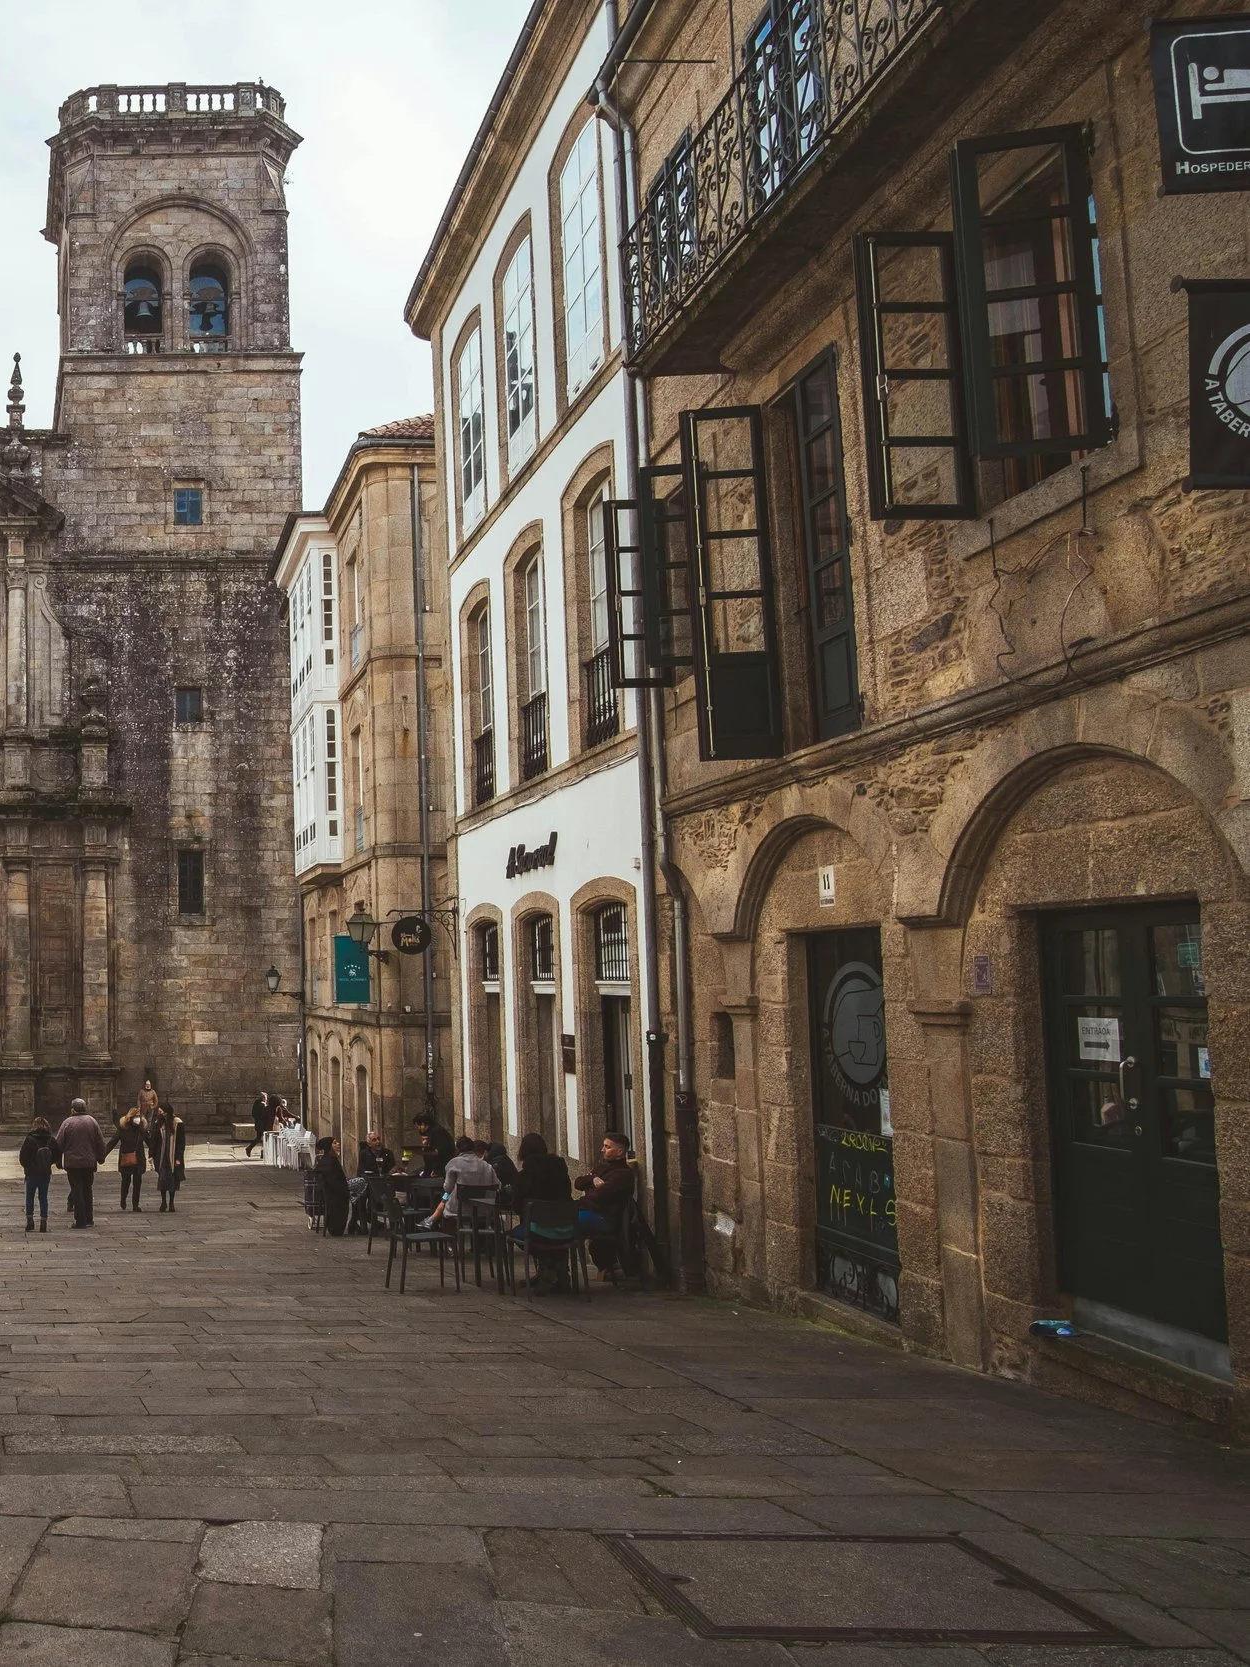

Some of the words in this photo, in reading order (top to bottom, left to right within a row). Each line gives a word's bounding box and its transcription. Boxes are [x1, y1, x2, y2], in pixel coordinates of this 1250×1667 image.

[1204, 378, 1220, 391] A
[822, 872, 831, 891] 11
[1081, 1026, 1111, 1036] ENTRADA
